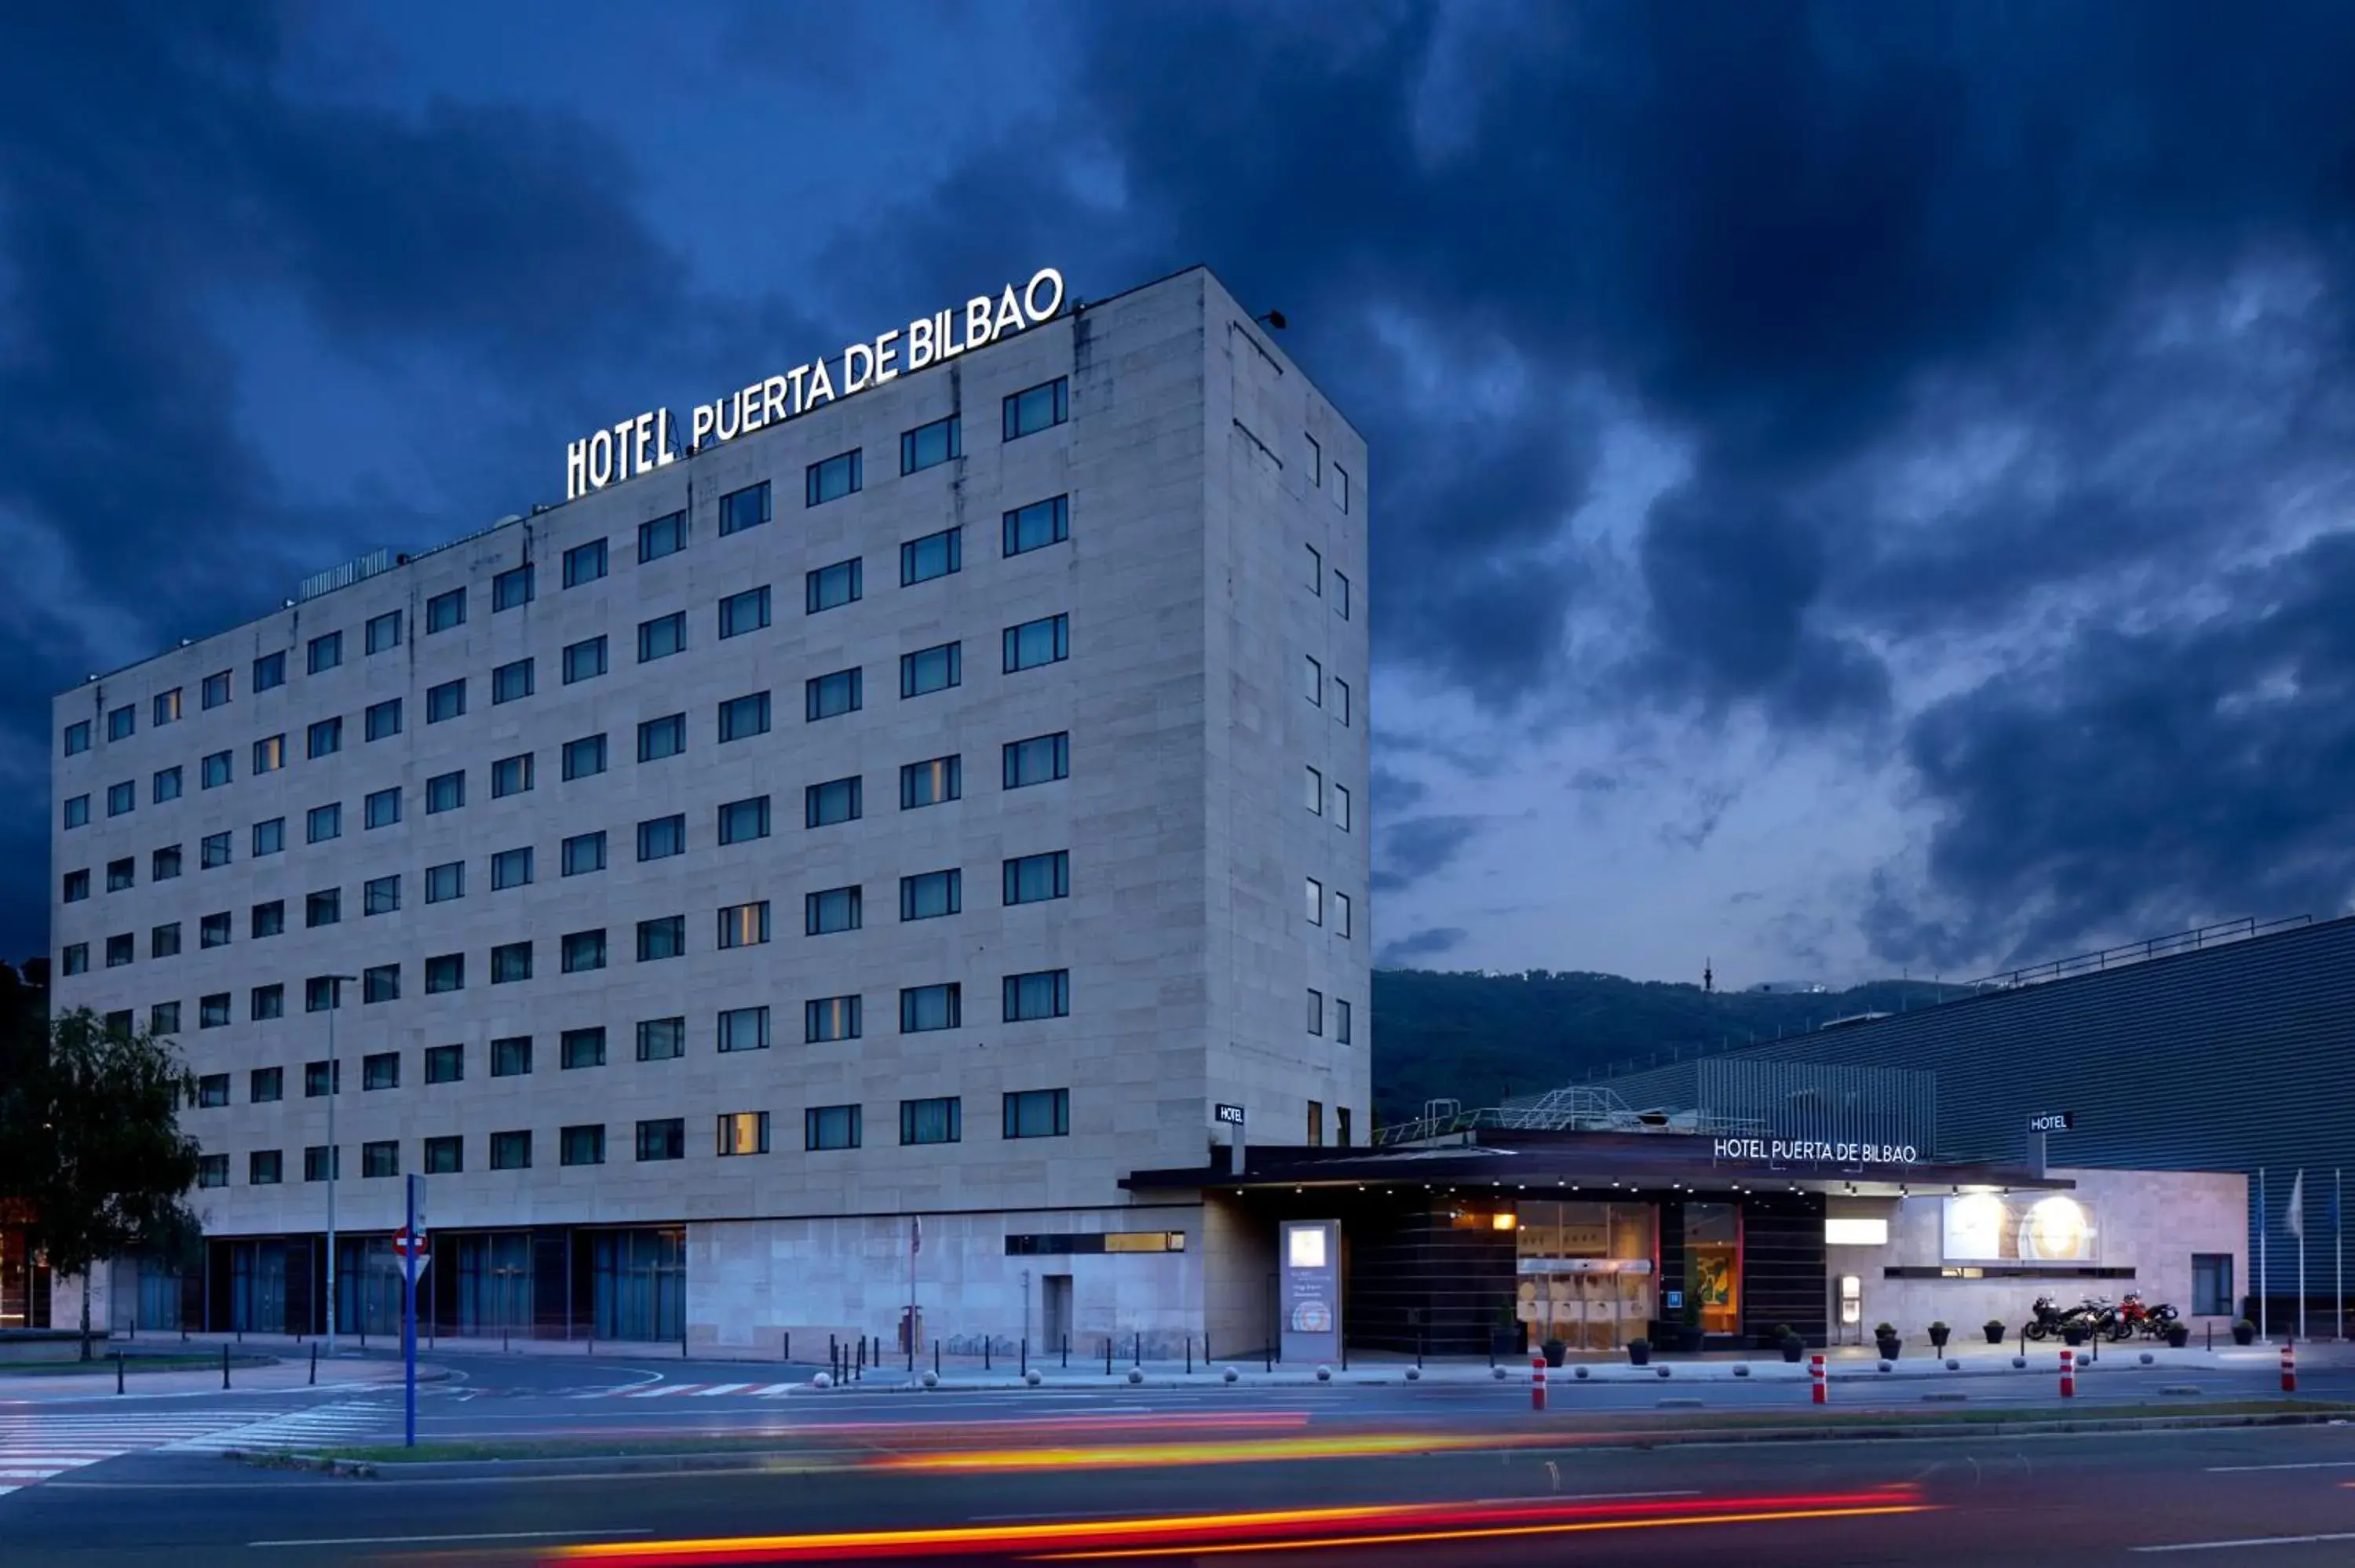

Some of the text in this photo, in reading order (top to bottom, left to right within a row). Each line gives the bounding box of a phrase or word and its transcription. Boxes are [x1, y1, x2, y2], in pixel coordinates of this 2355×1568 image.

[567, 268, 1064, 499] HOTEL PUERTA DE BILBAO
[1221, 1106, 1243, 1123] HOTEL
[2031, 1115, 2067, 1131] HOTEL
[1714, 1138, 1916, 1163] HOTEL PUERTA DE BILBAO
